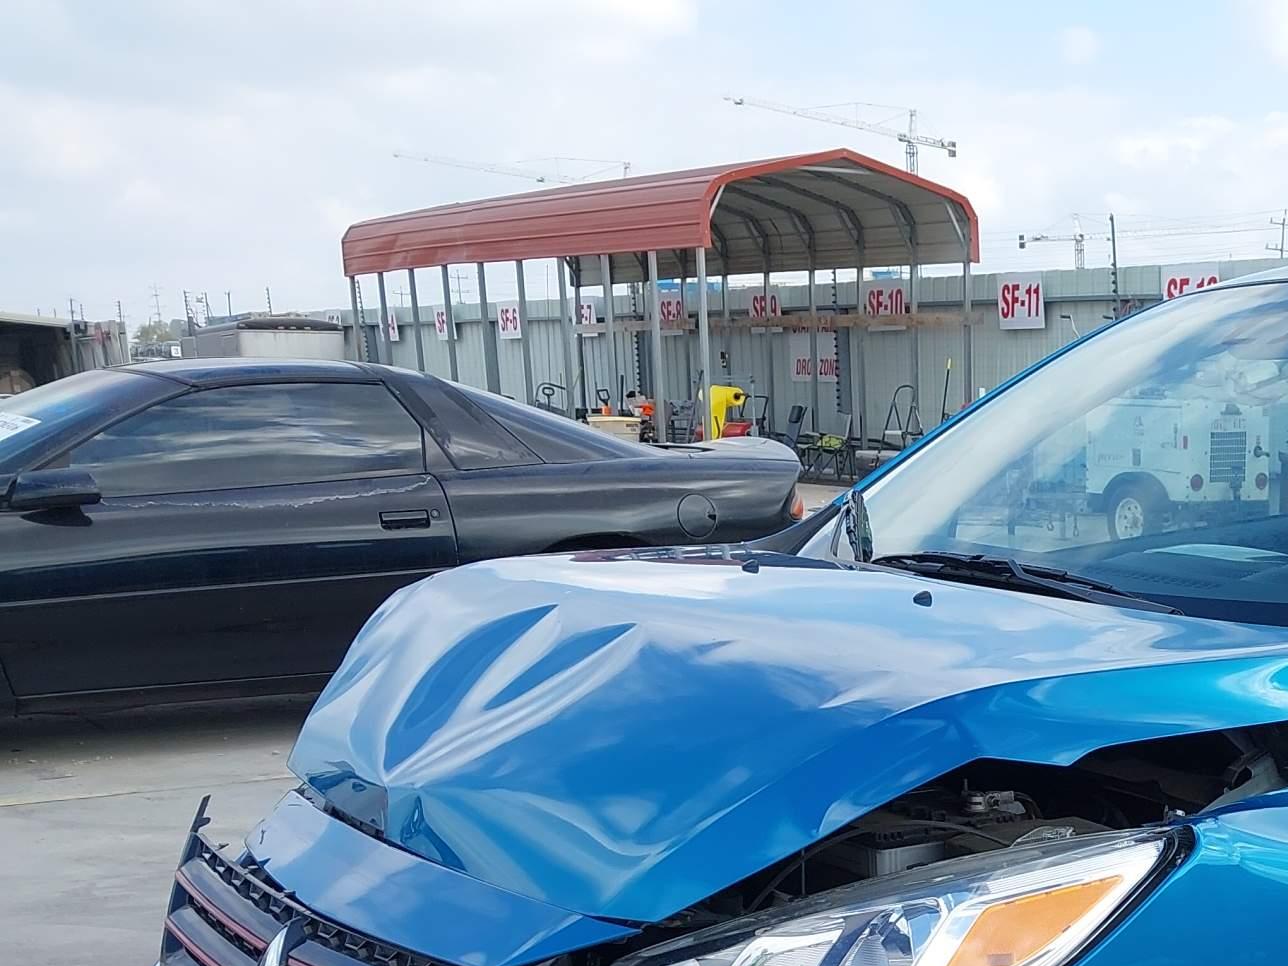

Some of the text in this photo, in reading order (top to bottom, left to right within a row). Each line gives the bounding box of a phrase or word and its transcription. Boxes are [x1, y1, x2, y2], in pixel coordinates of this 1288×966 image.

[868, 288, 903, 315] SF-10
[1001, 283, 1040, 319] SF-11
[500, 308, 518, 332] SF-6
